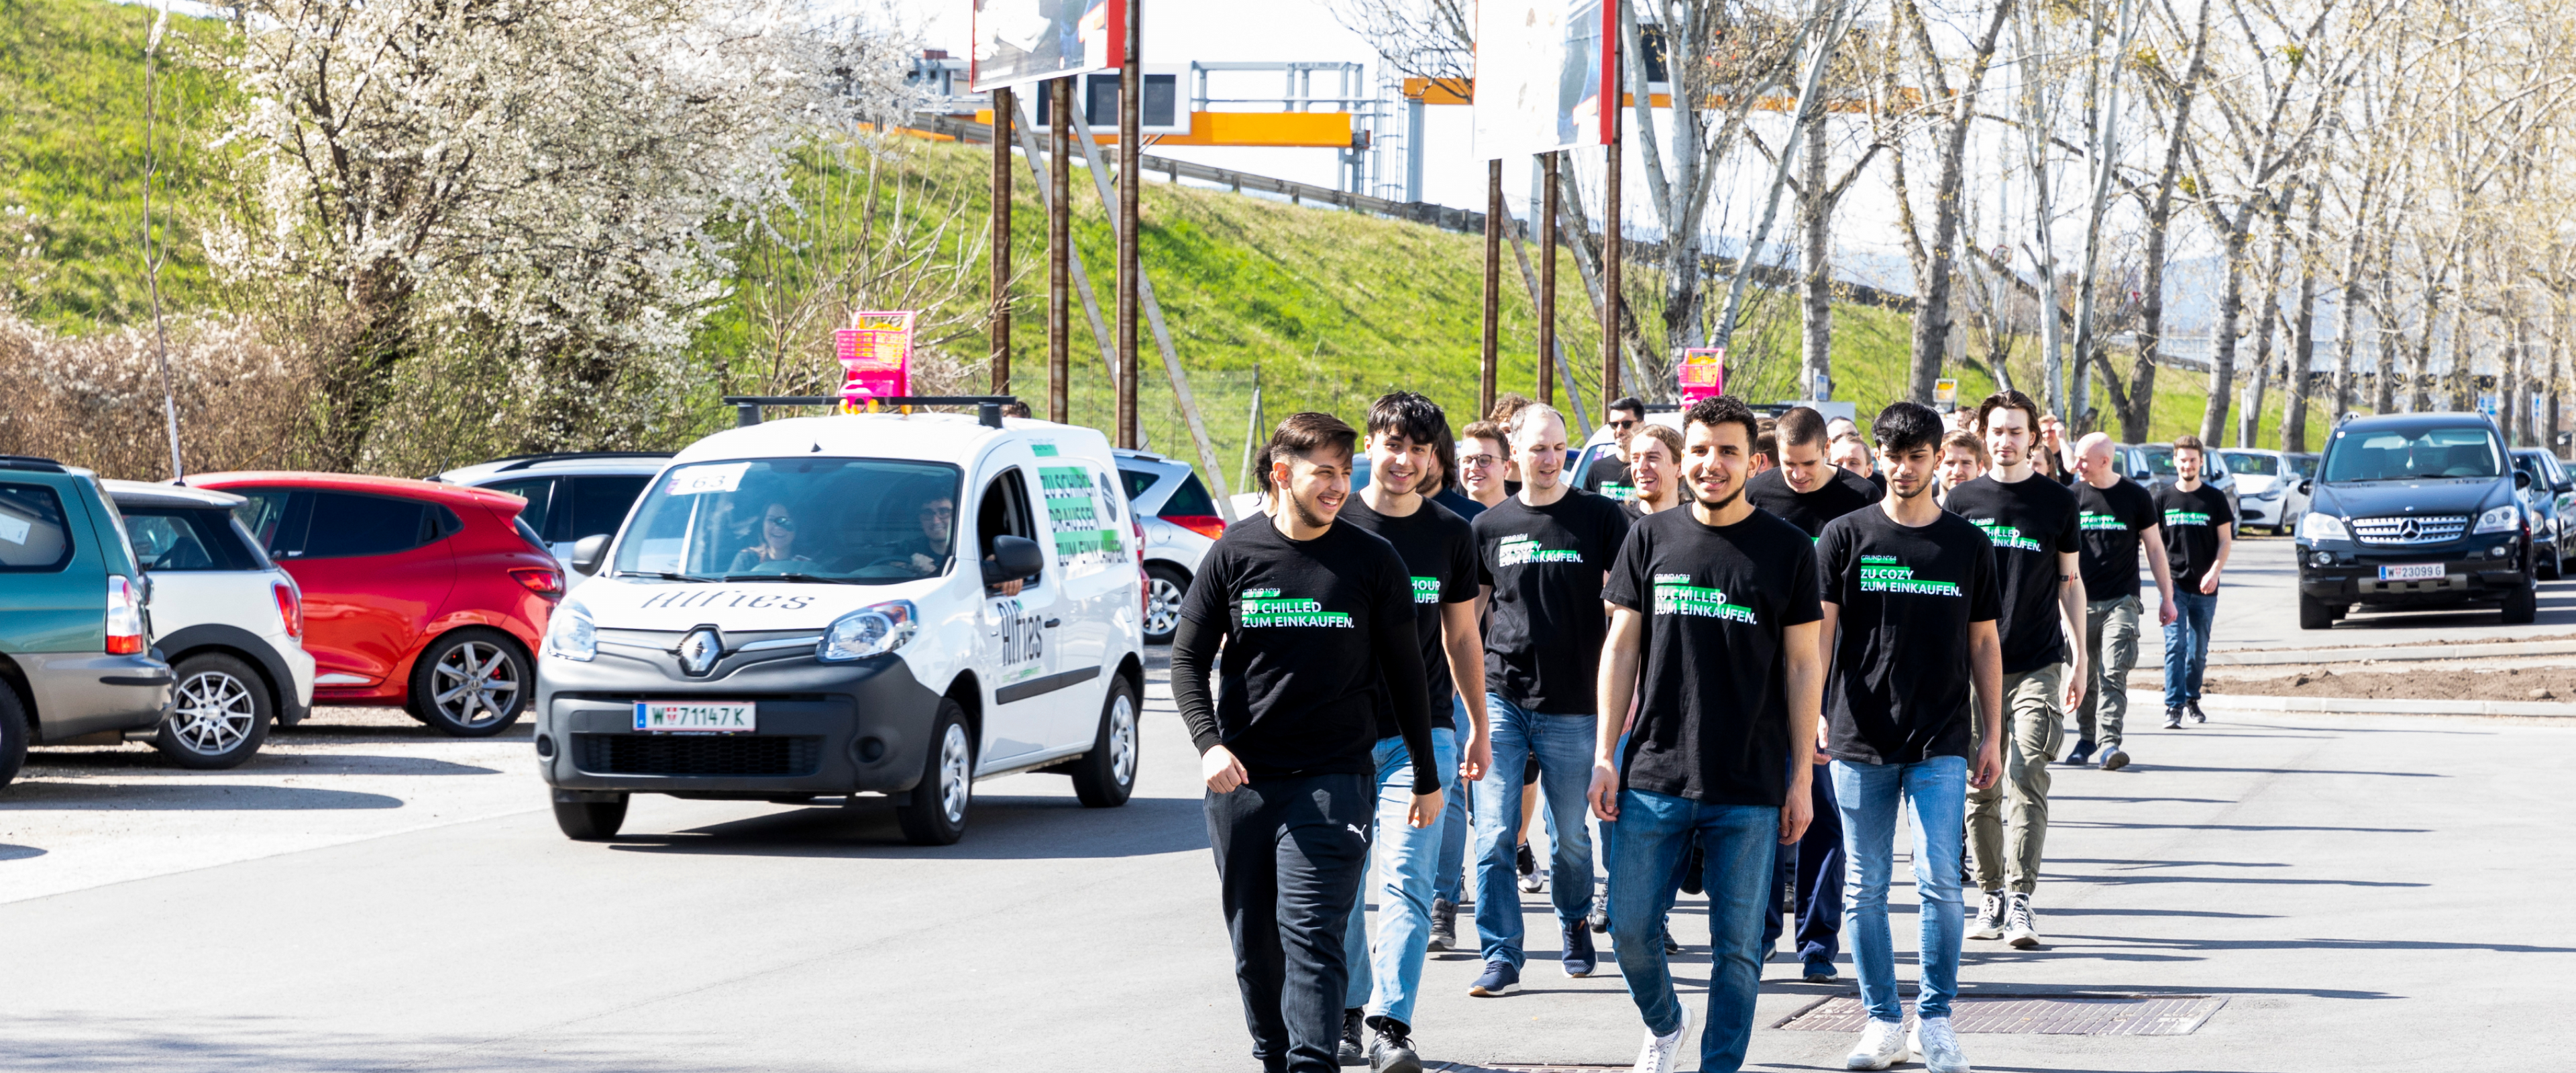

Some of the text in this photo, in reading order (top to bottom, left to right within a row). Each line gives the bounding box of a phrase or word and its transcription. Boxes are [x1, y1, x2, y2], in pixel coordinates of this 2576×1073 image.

[1985, 528, 2021, 539] HILLED
[1860, 569, 1914, 580] ZU COZY
[2402, 566, 2433, 577] 23099
[1860, 581, 1962, 597] ZUM EINKAUFEN.
[1654, 588, 1727, 605] ZU CHILLED
[1241, 601, 1322, 615] ZU CHILLED
[1654, 602, 1758, 625] ZUM EINKAUFEN.
[1242, 615, 1355, 628] ZUM EINKAUFEN.
[651, 707, 745, 726] W 71147 K
